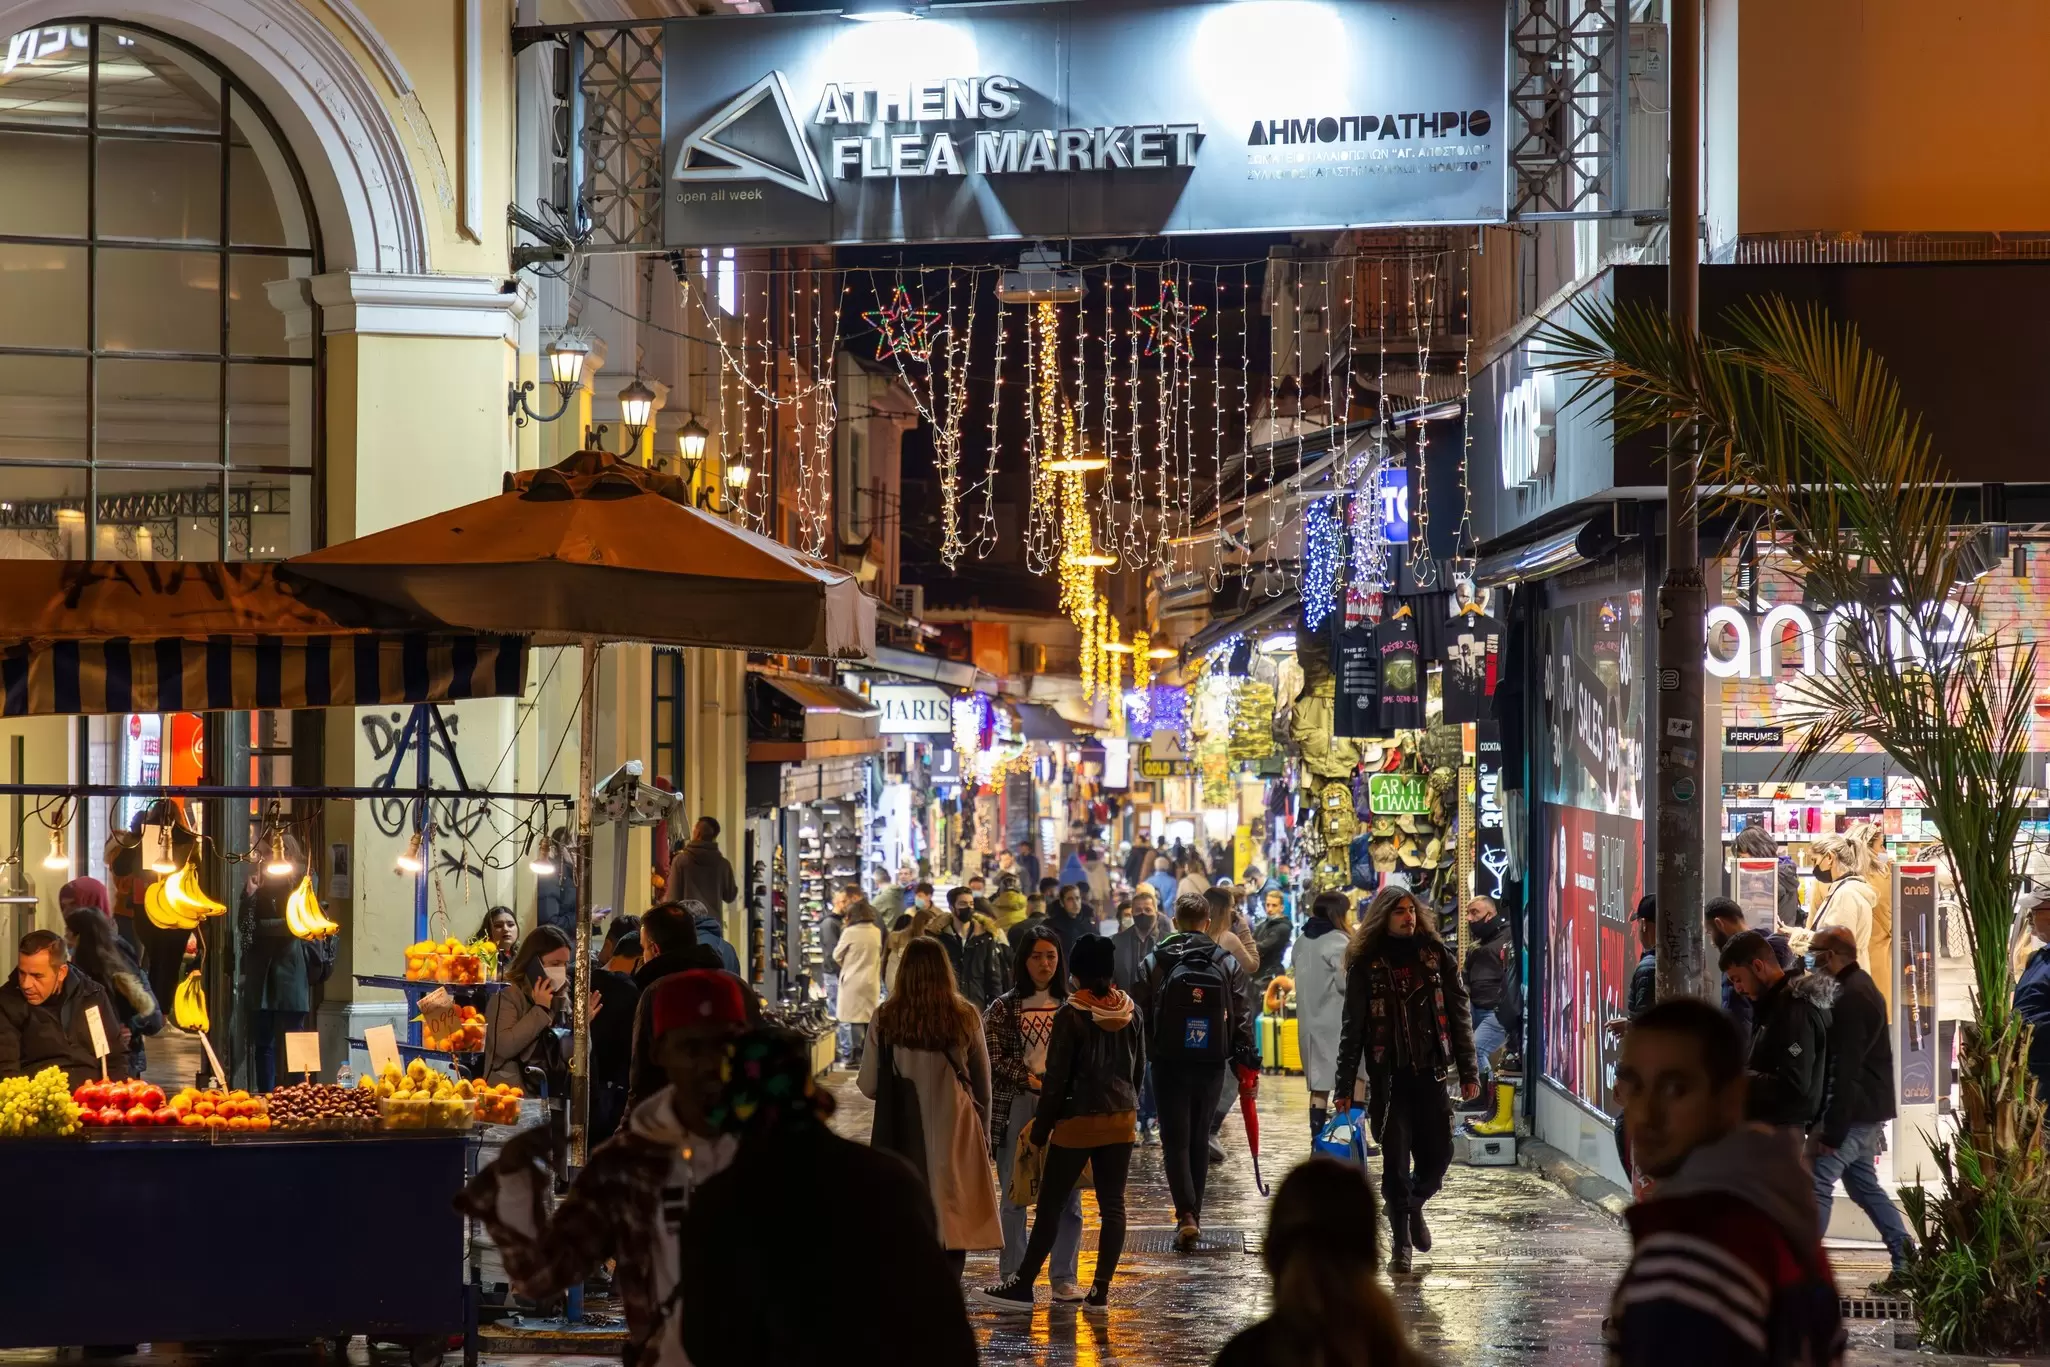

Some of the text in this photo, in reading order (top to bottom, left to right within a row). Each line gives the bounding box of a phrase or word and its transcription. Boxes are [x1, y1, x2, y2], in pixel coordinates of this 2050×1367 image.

[815, 76, 1020, 125] ATHENS
[1247, 108, 1492, 146] ΔΗΜΟΠΡΑΤΗΡΙΟ
[832, 122, 1206, 180] FLEA MARKET
[676, 187, 763, 205] open all week
[1703, 599, 1973, 679] annie
[1578, 681, 1603, 763] SALES
[1480, 742, 1502, 752] COCKTA
[1730, 732, 1780, 742] PERFUMES
[1379, 779, 1424, 795] ARMY
[1904, 884, 1930, 895] annie
